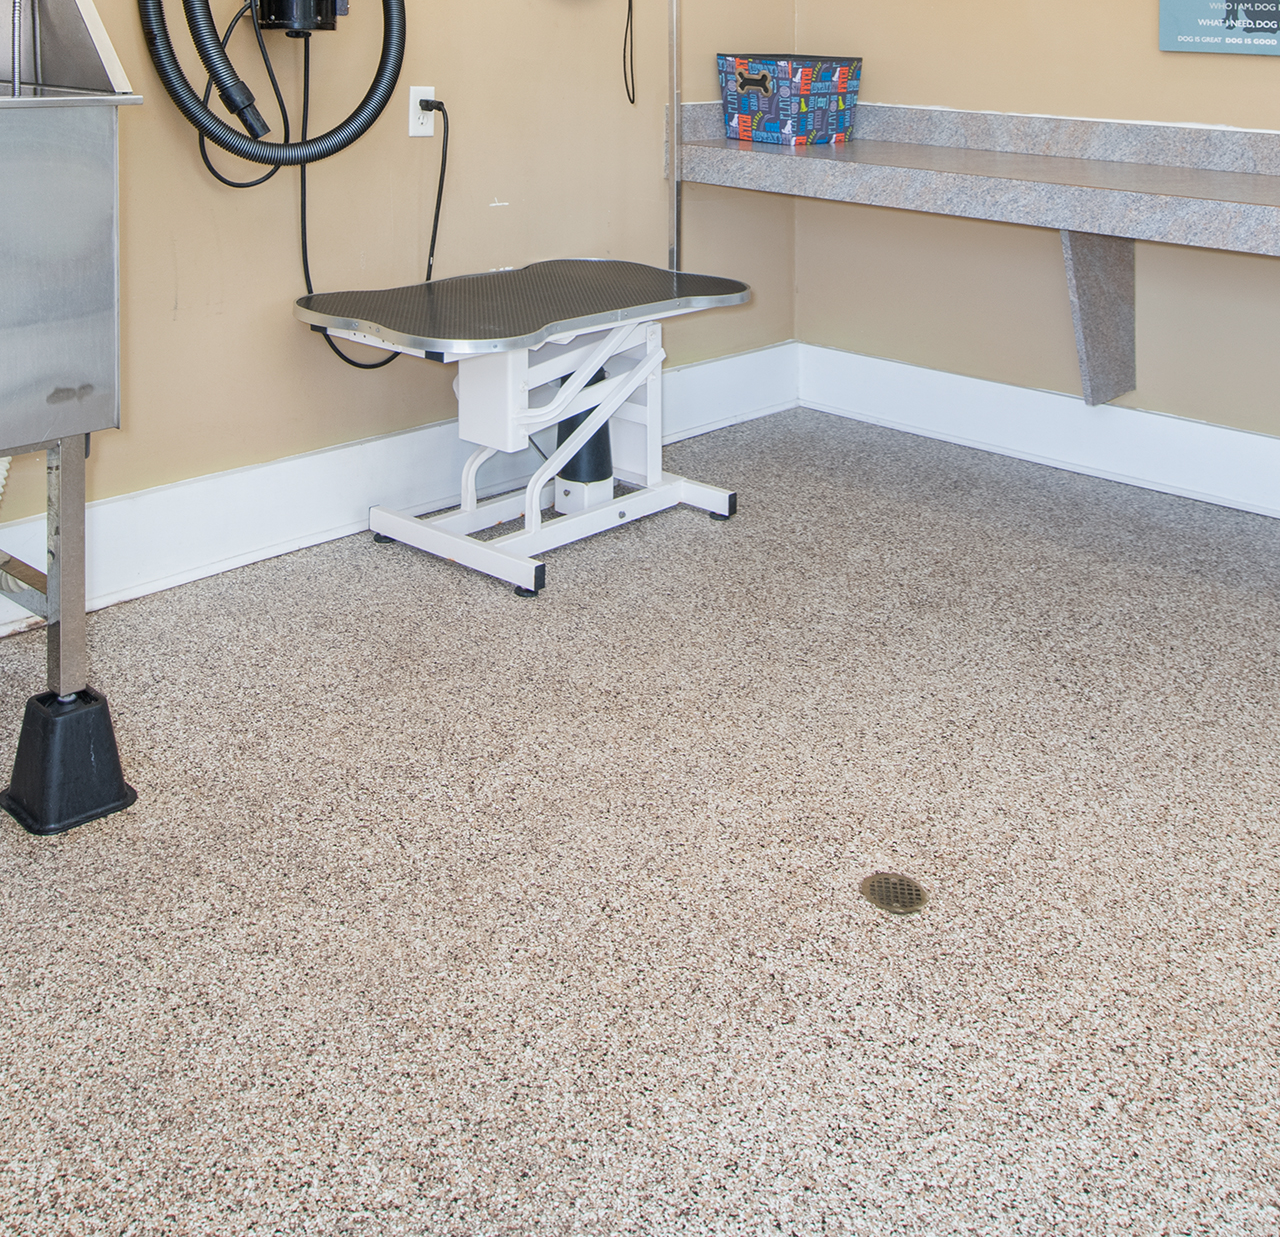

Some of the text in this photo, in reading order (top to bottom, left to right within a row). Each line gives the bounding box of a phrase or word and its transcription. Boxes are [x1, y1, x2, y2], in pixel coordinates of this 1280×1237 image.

[1238, 3, 1253, 11] AM,
[1255, 3, 1276, 11] DOG
[1198, 19, 1224, 27] WHAT
[1230, 20, 1255, 28] NEED,
